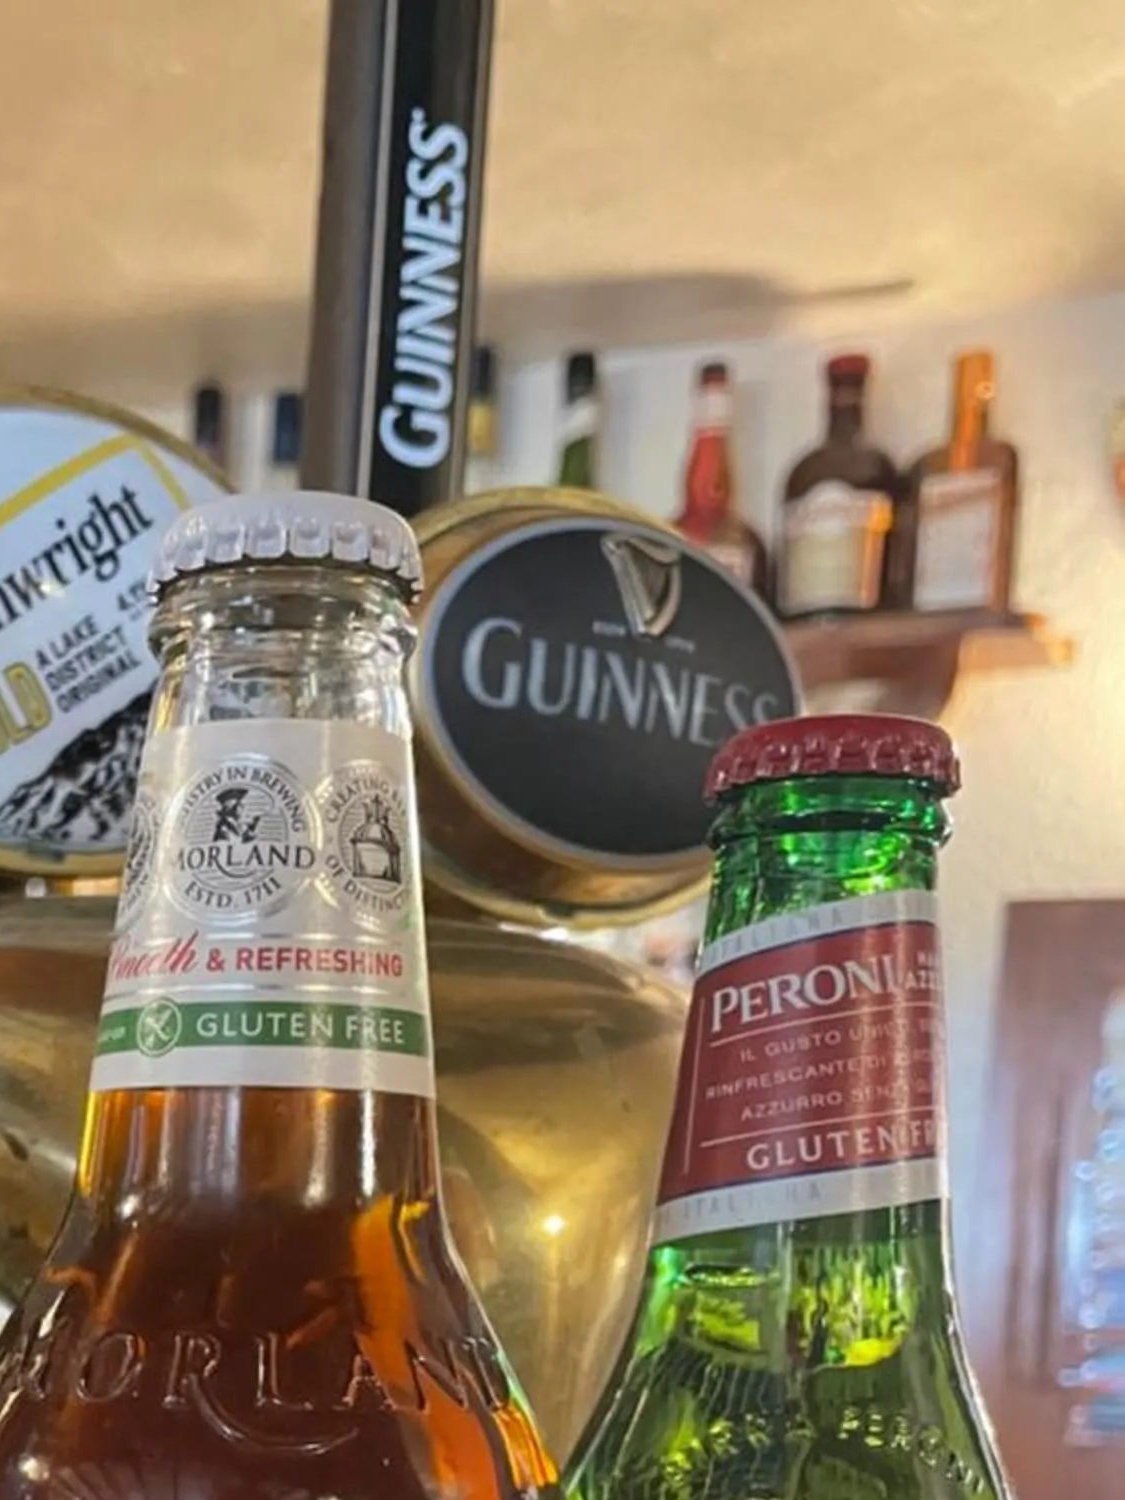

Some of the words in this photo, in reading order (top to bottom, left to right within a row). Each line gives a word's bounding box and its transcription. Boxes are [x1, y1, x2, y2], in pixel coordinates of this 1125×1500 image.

[378, 117, 470, 468] GUINNESS
[36, 649, 50, 671] A
[48, 614, 100, 662] LAKE
[44, 624, 128, 693] DISTRICT
[55, 650, 142, 715] ORIGINAL
[226, 766, 248, 781] IN
[207, 947, 225, 972] &
[236, 947, 403, 978] REFRESHING
[711, 954, 897, 1034] PERONI
[196, 1012, 336, 1039] GLUTEN
[345, 1014, 406, 1045] FREE
[764, 1029, 841, 1057] GUSTO
[746, 1122, 899, 1171] GLUTEN
